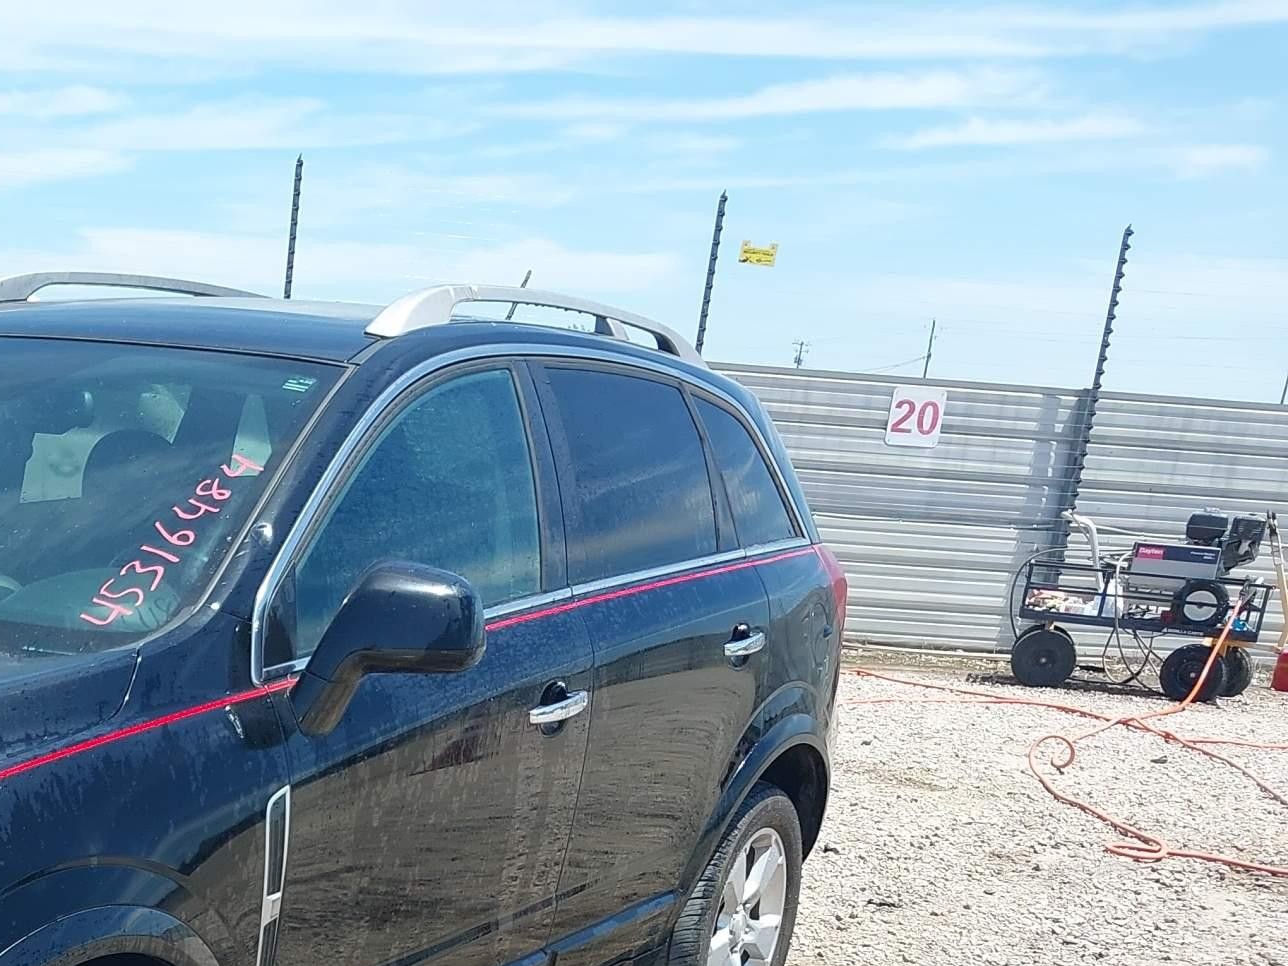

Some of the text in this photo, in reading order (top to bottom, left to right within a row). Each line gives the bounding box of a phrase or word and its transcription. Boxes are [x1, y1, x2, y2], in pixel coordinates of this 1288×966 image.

[890, 399, 940, 436] 20
[79, 453, 264, 626] 45316484
[1138, 547, 1164, 555] Dayton
